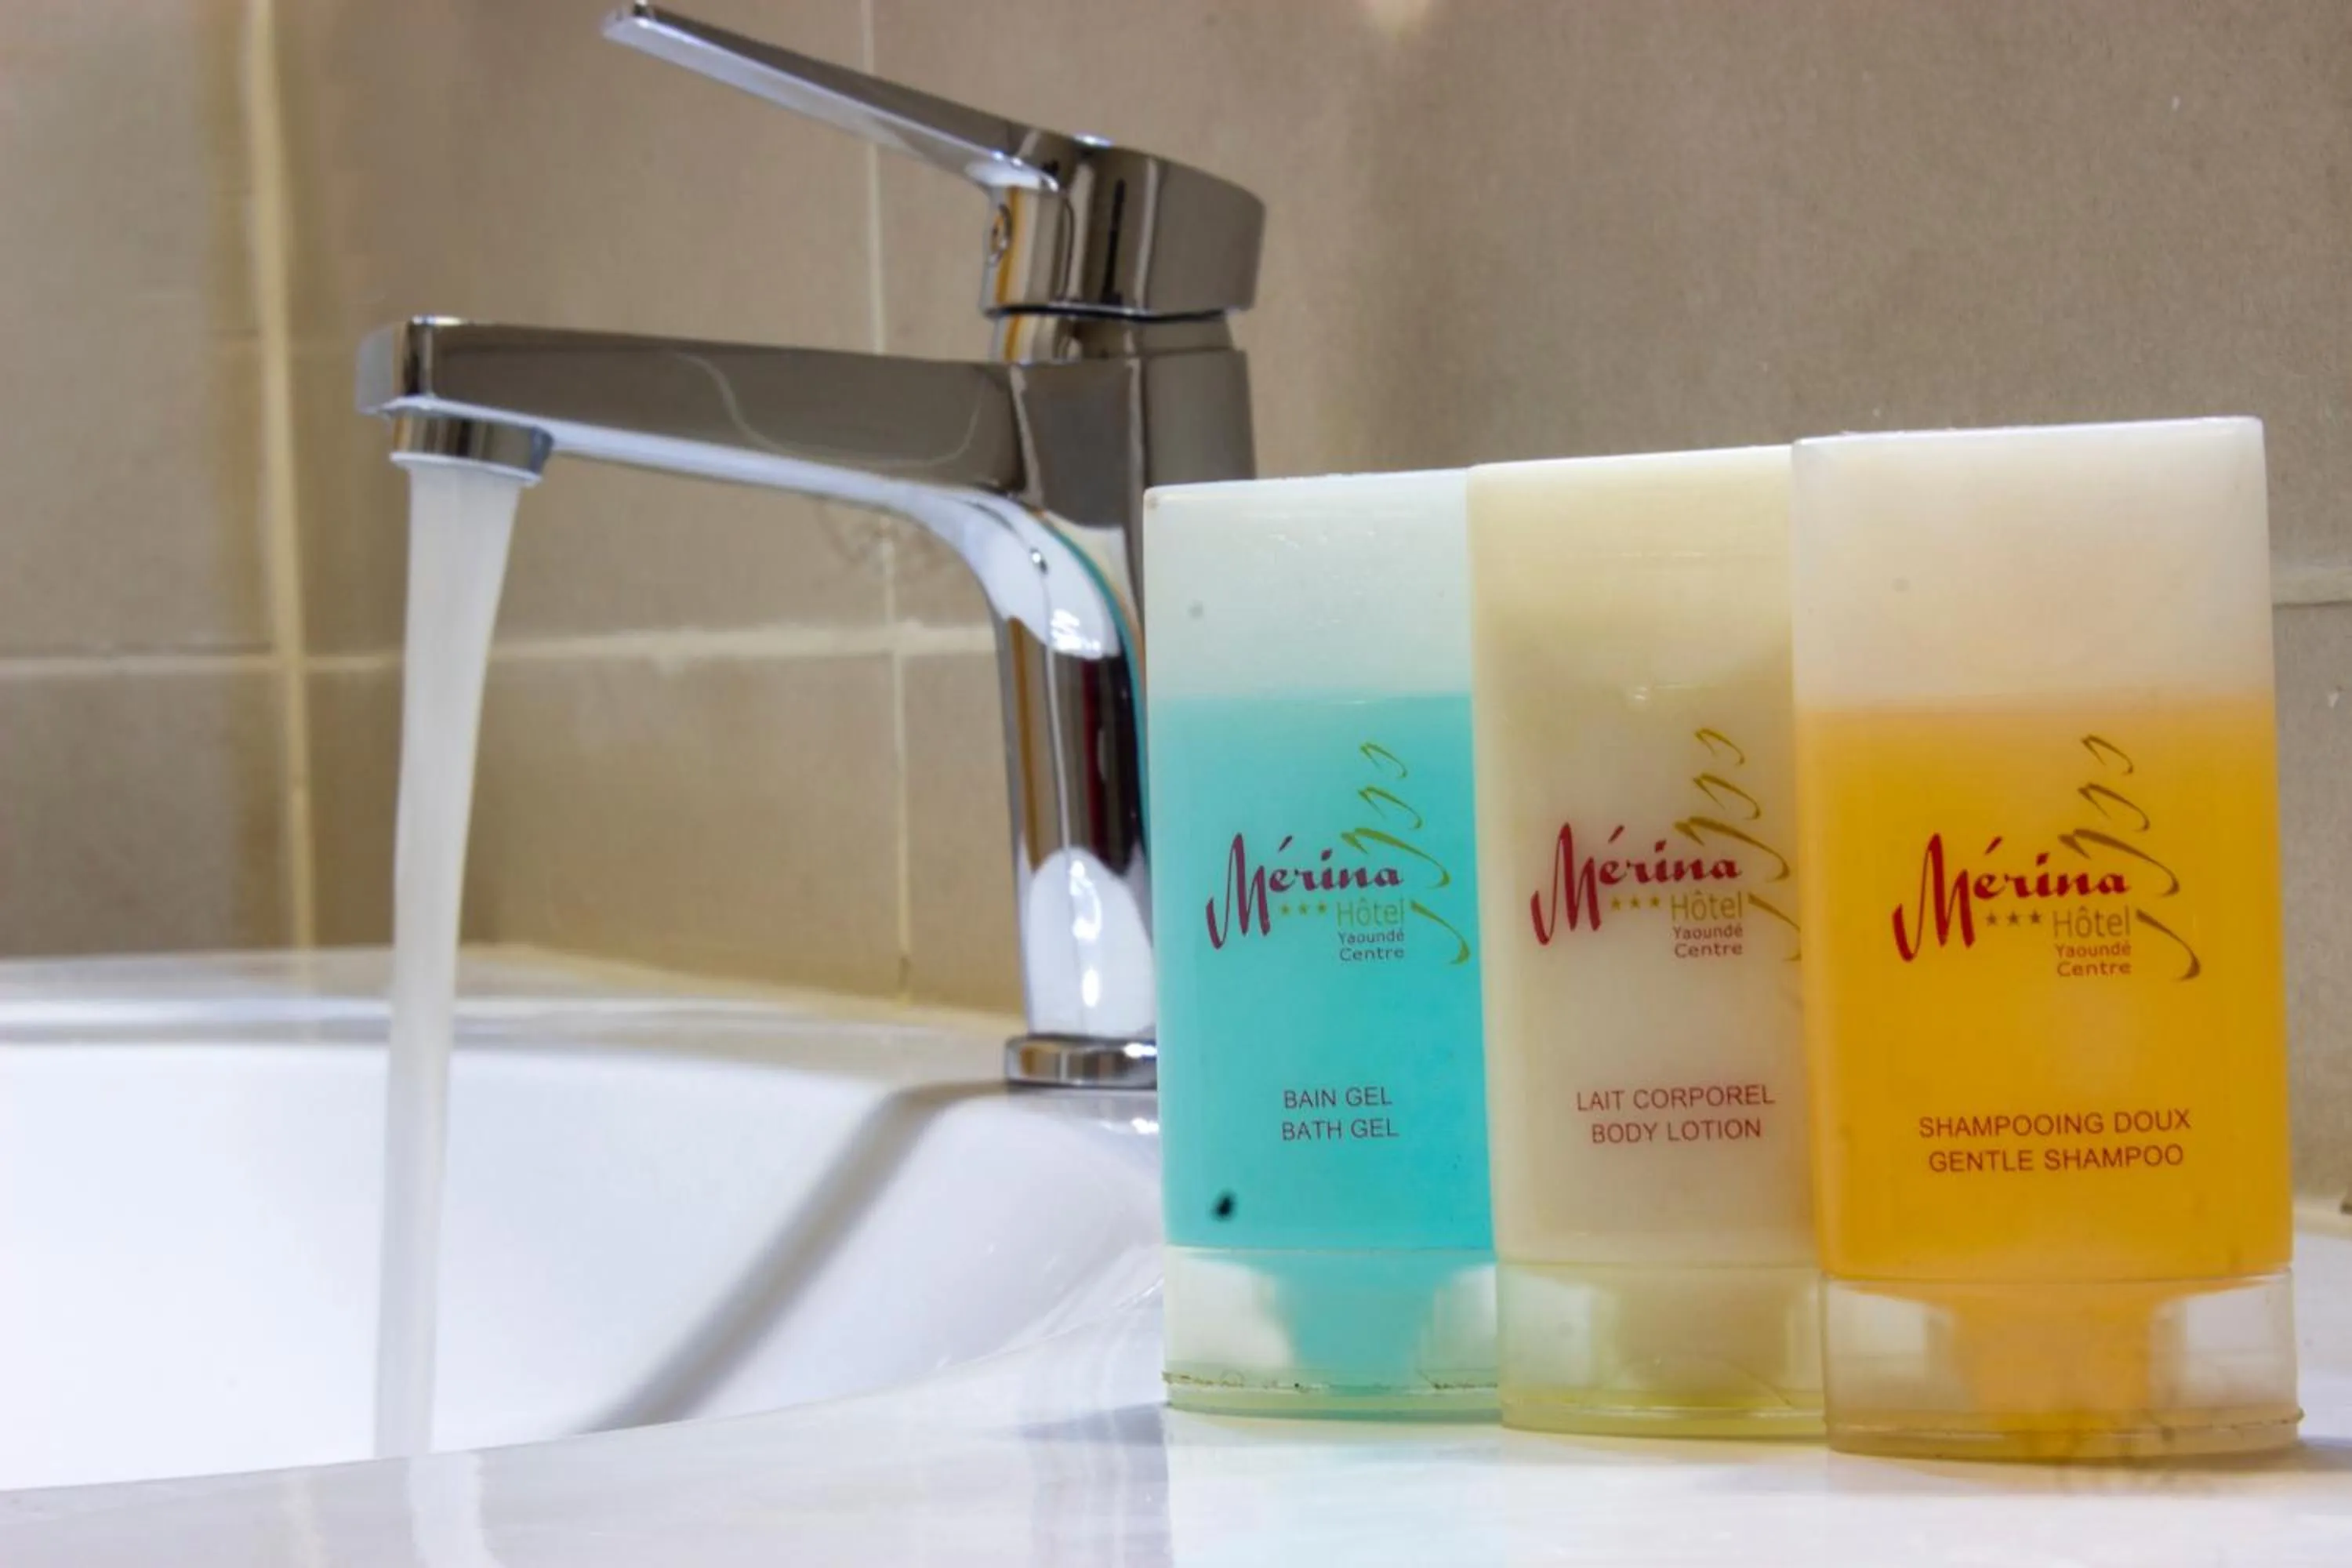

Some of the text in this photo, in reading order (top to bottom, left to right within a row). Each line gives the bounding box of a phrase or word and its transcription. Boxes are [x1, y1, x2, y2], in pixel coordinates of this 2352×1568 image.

[1206, 833, 1404, 949] Mérina
[1530, 822, 1742, 946] Mérina
[1671, 890, 1744, 921] Hôtel
[1892, 833, 2130, 962] Mérina
[1336, 898, 1405, 927] Hôtel
[2053, 906, 2131, 939] Hôtel
[1338, 929, 1405, 944] Yaoundé
[1673, 924, 1743, 940] Yaoundé
[1339, 946, 1405, 962] Centre
[1675, 942, 1743, 958] Centre
[2055, 941, 2132, 959] Yaoundé
[2056, 960, 2132, 977] Centre
[1283, 1087, 1392, 1109] BAIN GEL
[1577, 1085, 1776, 1112] LAIT CORPOREL
[1282, 1119, 1399, 1141] BATH GEL
[1592, 1119, 1762, 1144] BODY LOTION
[1919, 1109, 2191, 1138] SHAMPOOING DOUX
[1929, 1144, 2183, 1173] GENTLE SHAMPOO
